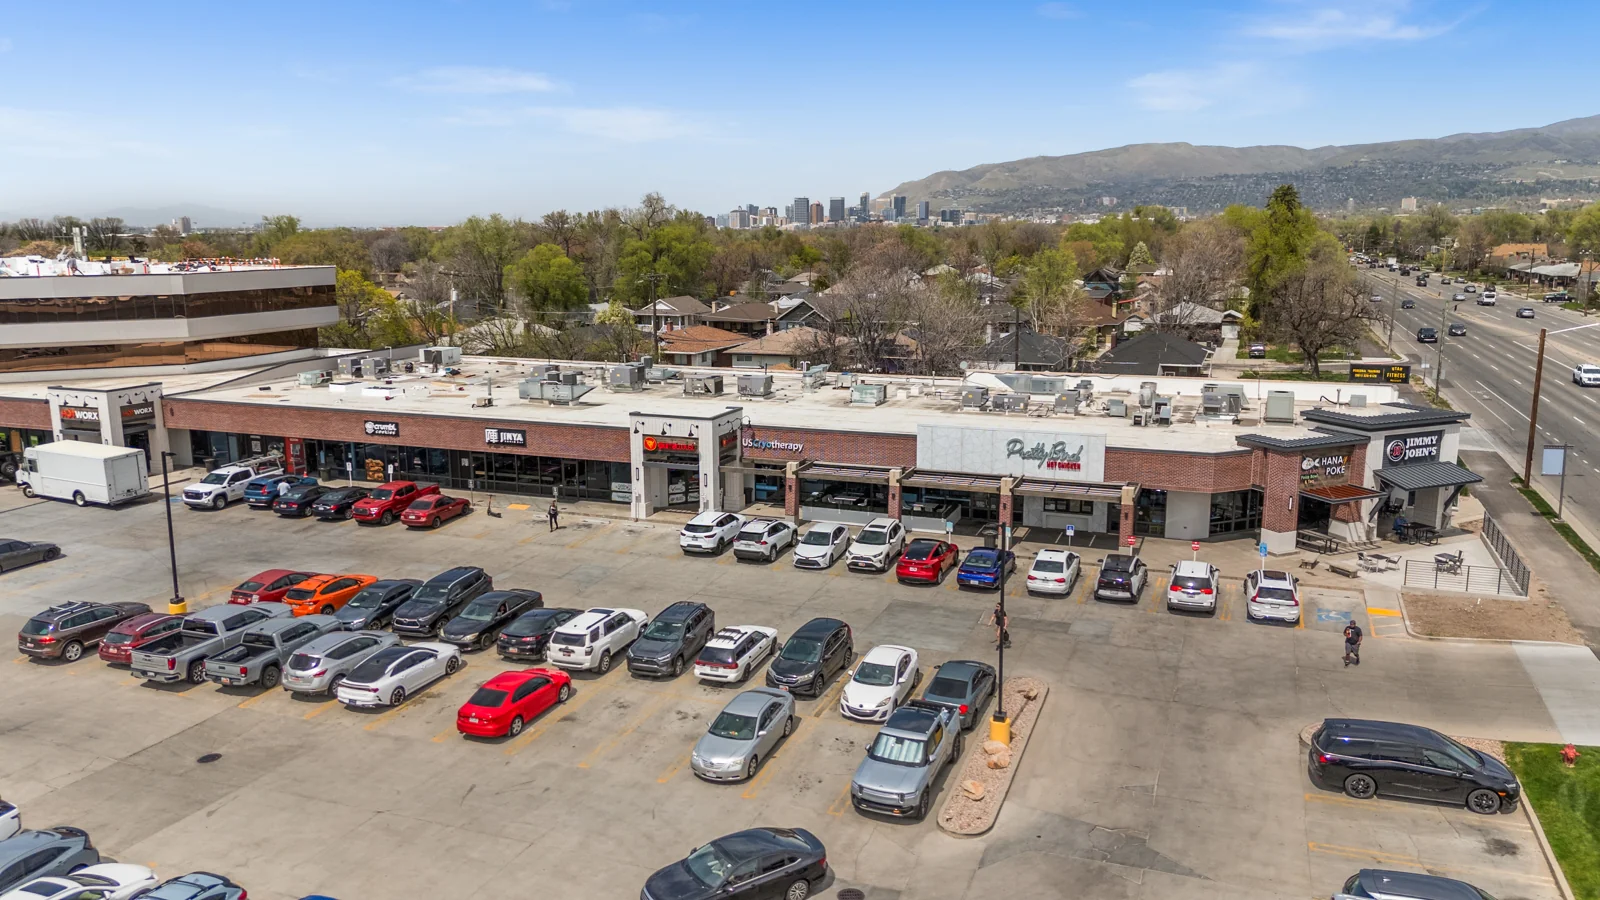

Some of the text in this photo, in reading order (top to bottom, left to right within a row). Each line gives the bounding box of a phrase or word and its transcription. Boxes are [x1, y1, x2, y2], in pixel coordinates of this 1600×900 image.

[500, 432, 524, 443] JINYA
[1405, 435, 1438, 449] JIMMY
[1404, 446, 1438, 460] JOHN'S
[1321, 455, 1344, 466] HANA
[1325, 465, 1346, 476] POKE
